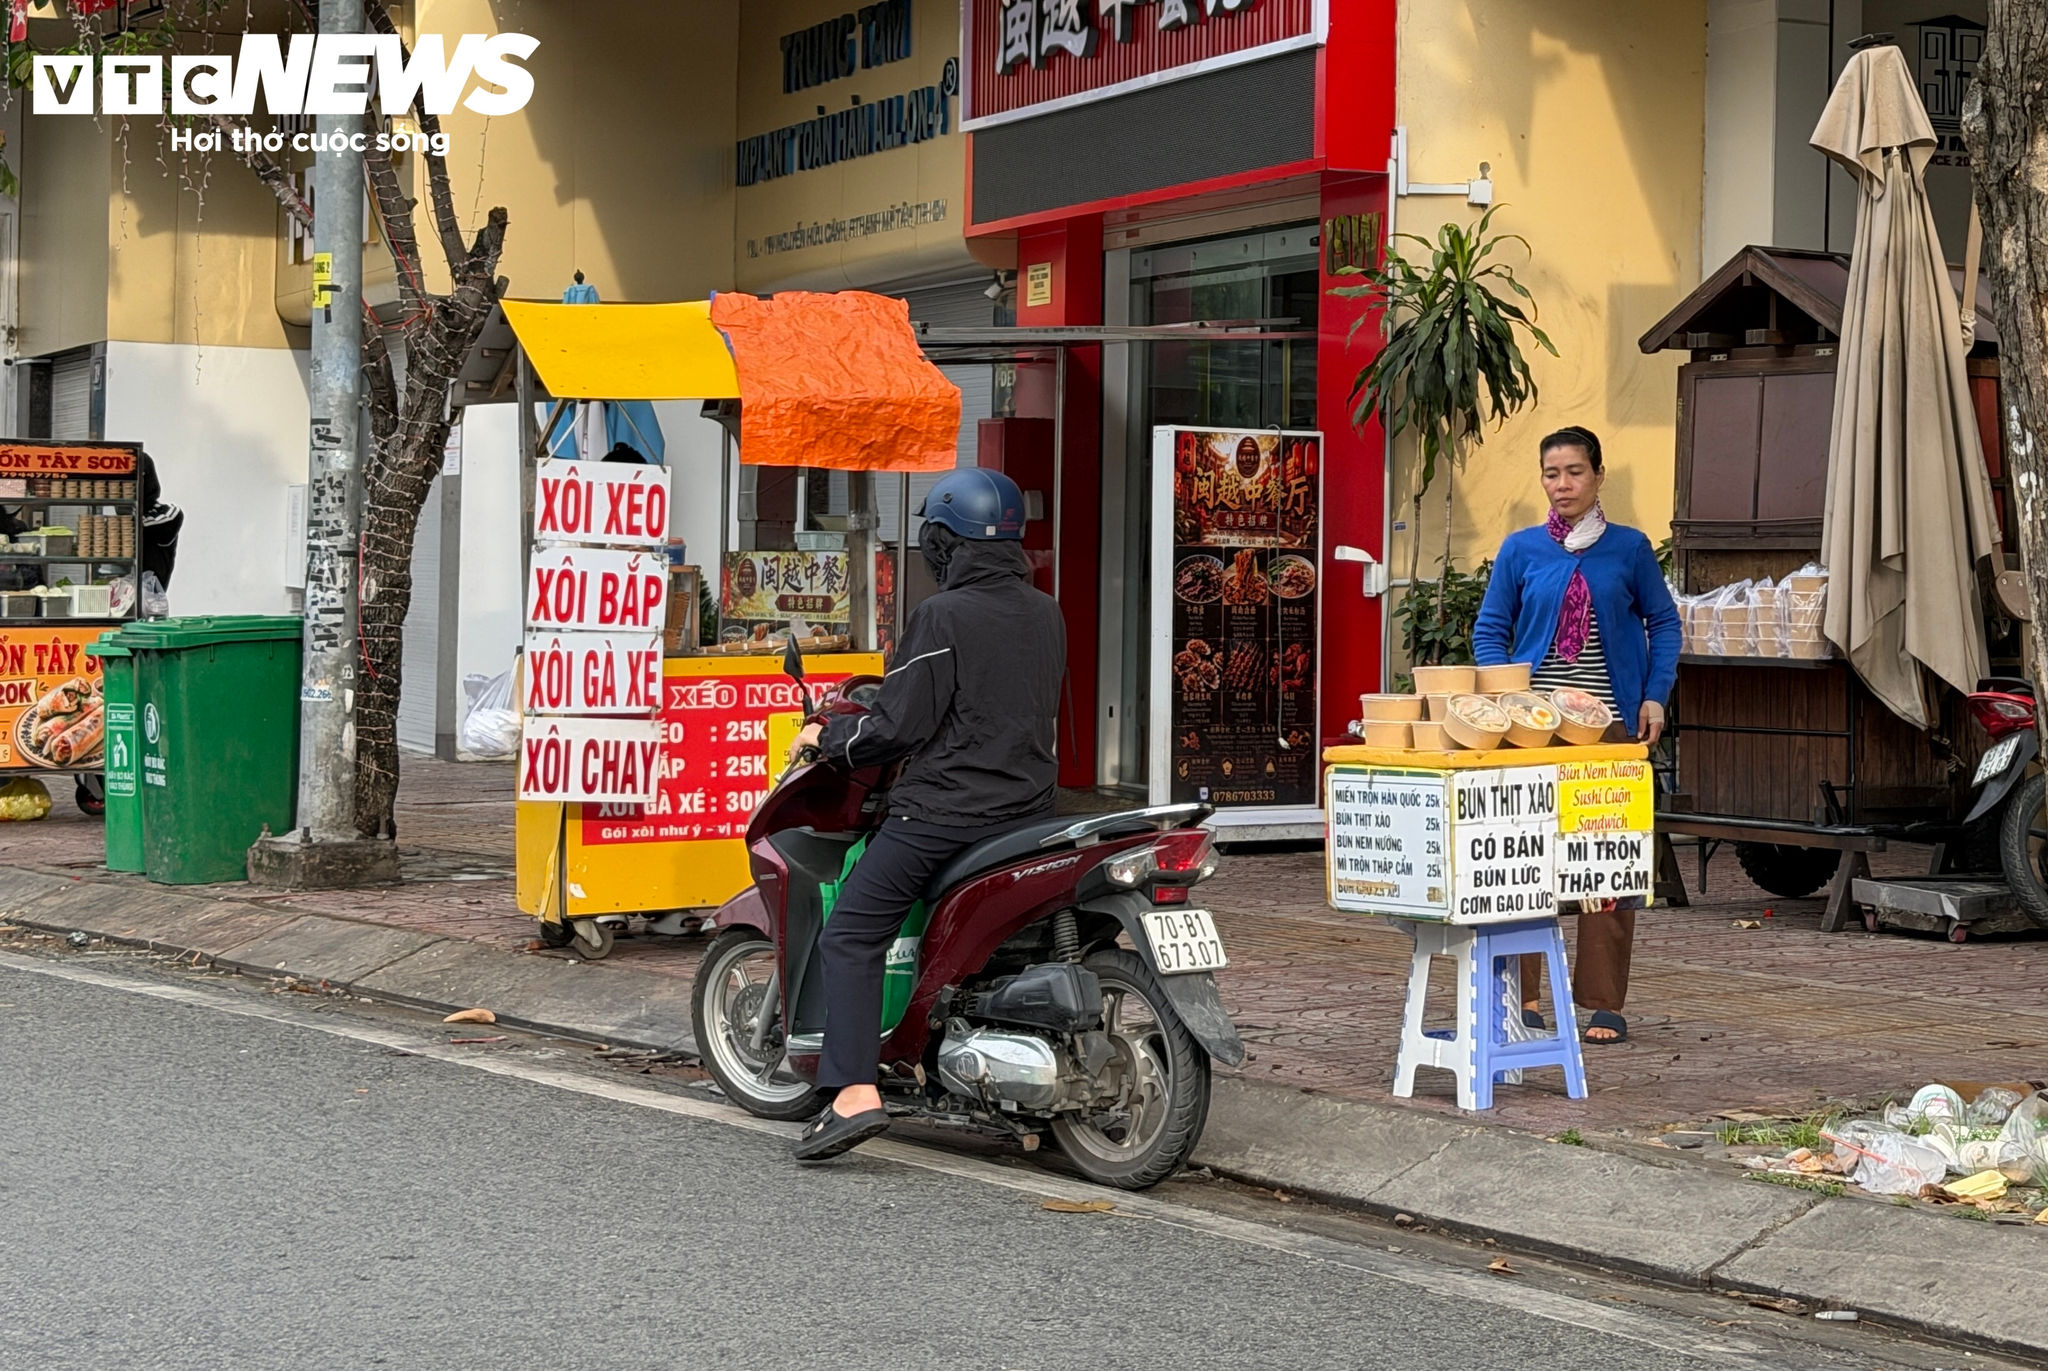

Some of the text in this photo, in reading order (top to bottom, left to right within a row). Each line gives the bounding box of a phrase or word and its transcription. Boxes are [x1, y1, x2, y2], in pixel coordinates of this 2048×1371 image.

[780, 13, 856, 94] TRUNG
[37, 452, 82, 469] TÂY
[87, 455, 131, 470] SƠN
[538, 466, 666, 538] XÔI XÉO
[1191, 467, 1309, 515] 闽越中餐厅
[531, 554, 663, 627] XÔI BẮP
[34, 636, 80, 675] TÂY
[528, 637, 659, 708] XÔI GÀ XÉ
[670, 680, 737, 709] XÉO
[659, 718, 684, 744] ÉO
[726, 720, 767, 742] 25K
[522, 725, 659, 795] XÔI CHAY
[658, 751, 686, 779] ẮP
[726, 755, 767, 777] 25K
[1559, 762, 1645, 781] Bún Nem Nướng
[679, 787, 706, 814] XÉ
[1213, 790, 1275, 801] 0786703333
[1335, 785, 1355, 804] MIẾN
[1381, 788, 1398, 805] HÀN
[1400, 788, 1421, 808] QUỐC
[1458, 773, 1555, 824] BÚN THỊT XÀO
[1605, 787, 1631, 807] Cuộn
[602, 825, 627, 839] Gói
[632, 825, 654, 838] xôi
[660, 825, 689, 836] như
[718, 822, 731, 835] vị
[1336, 809, 1352, 826] BÚN
[1354, 813, 1372, 830] THỊT
[1375, 811, 1391, 828] XÀO
[1577, 813, 1628, 832] Sandwich
[1336, 831, 1353, 848] BÚN
[1355, 836, 1372, 850] NEM
[1471, 830, 1544, 861] CÓ BÁN
[1567, 836, 1588, 862] MÌ
[1012, 854, 1084, 882] VISION
[1337, 854, 1347, 871] MÌ
[1349, 855, 1370, 875] TRỘN
[1372, 857, 1393, 877] THẬP
[1473, 863, 1541, 888] BÚN LỨC
[1558, 860, 1649, 897] THẬP CẨM
[1460, 888, 1554, 916] CƠM GẠO LỨC
[1154, 911, 1208, 941] 70-B1
[1158, 940, 1221, 970] 673.07
